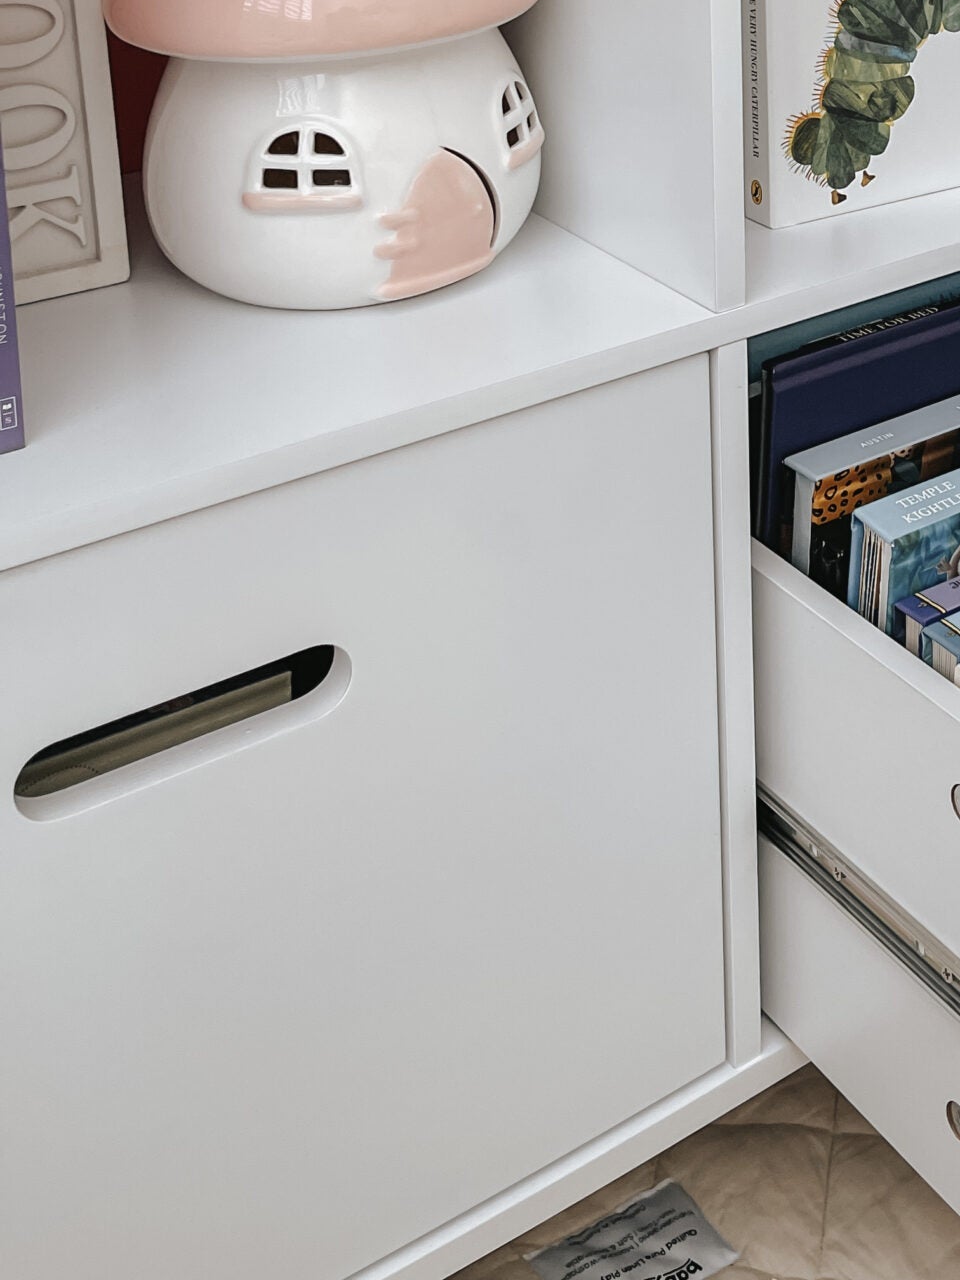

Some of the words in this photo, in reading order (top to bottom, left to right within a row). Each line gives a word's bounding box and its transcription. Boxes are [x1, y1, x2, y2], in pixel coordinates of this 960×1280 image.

[749, 8, 758, 37] VERY
[750, 39, 759, 83] HUNGRY
[750, 85, 760, 158] CATERPILLAR
[839, 324, 877, 342] TIME
[877, 317, 909, 330] FOR
[908, 306, 939, 320] BED
[860, 432, 894, 448] AUSTIN
[896, 480, 957, 509] TEMPLE
[645, 1247, 666, 1260] Pure
[665, 1229, 698, 1251] Quilted
[621, 1258, 646, 1273] Linen
